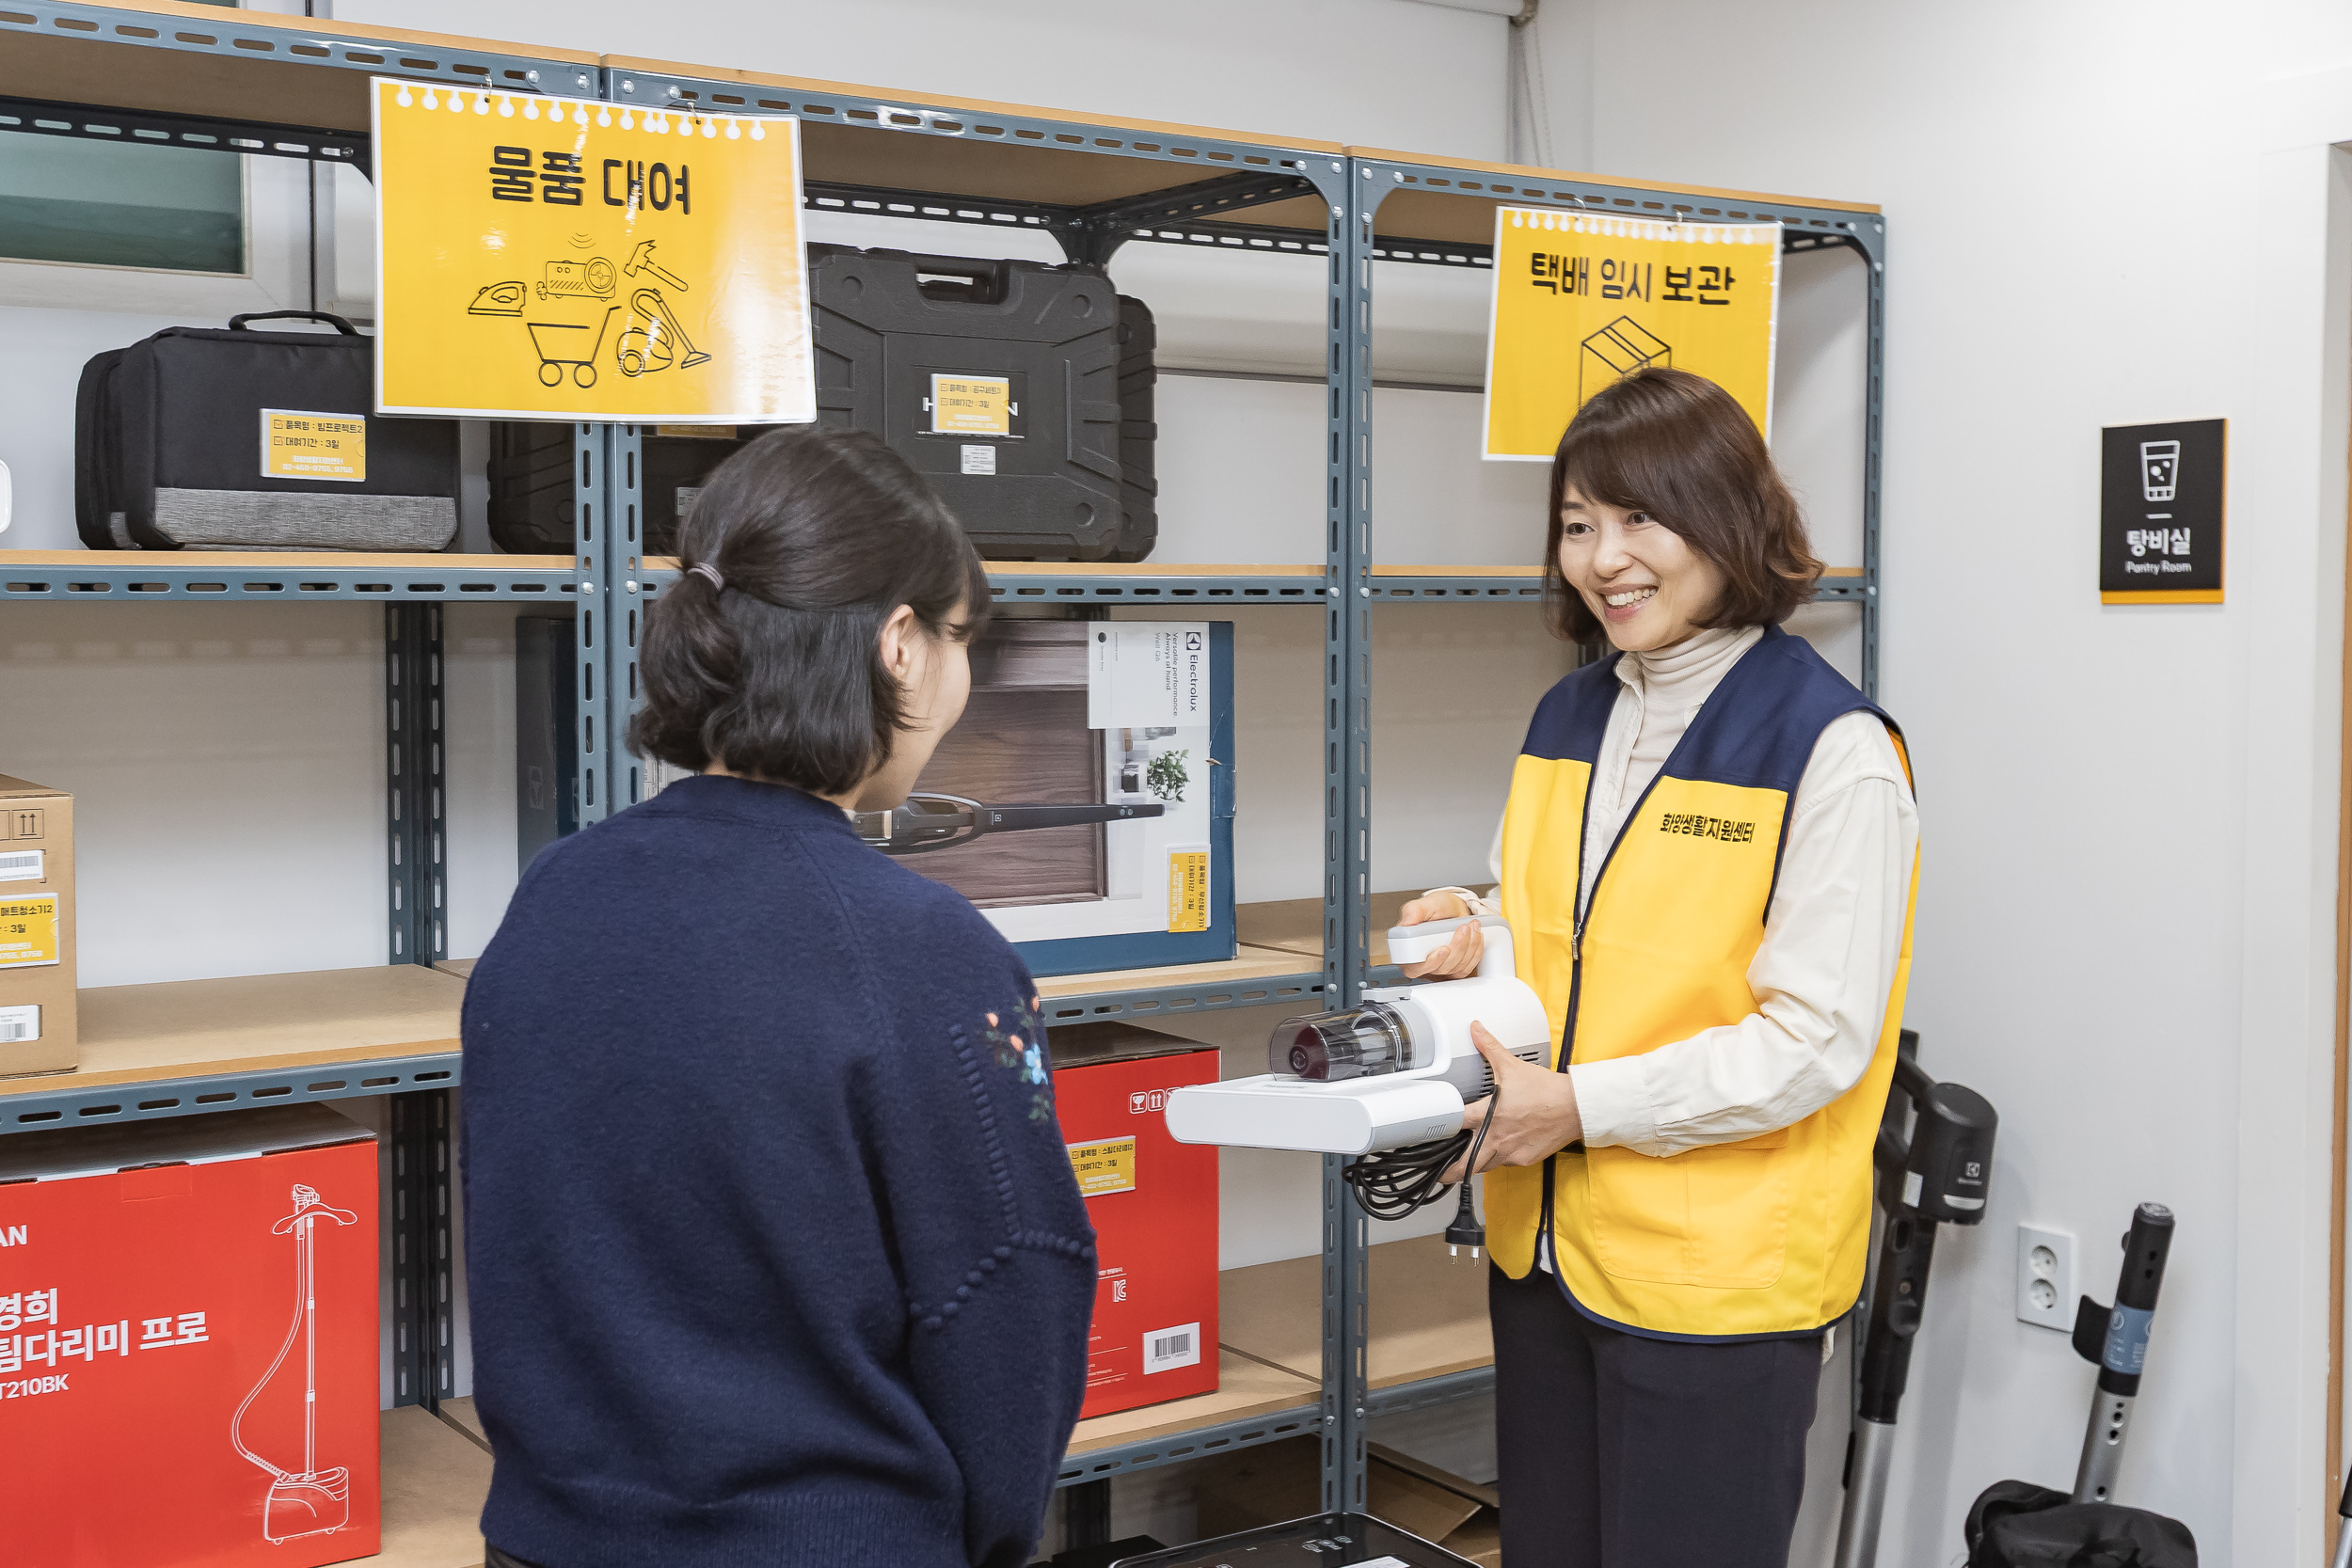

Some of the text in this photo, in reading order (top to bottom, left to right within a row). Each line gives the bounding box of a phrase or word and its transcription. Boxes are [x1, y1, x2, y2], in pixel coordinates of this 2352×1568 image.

[488, 145, 691, 215] 물품 대여
[1531, 252, 1737, 306] 택배 임시 보관
[285, 420, 310, 431] 품목명
[317, 422, 363, 434] 빔프로젝트2
[285, 436, 318, 448] 대여기간
[325, 439, 340, 450] 3일
[2126, 527, 2191, 558] 탕비실
[2124, 560, 2192, 576] Pantry Room
[1166, 660, 1172, 669] at
[1189, 655, 1199, 712] Electrolux
[0, 904, 53, 916] 매트청소기2
[9, 924, 26, 934] 3일
[139, 1310, 210, 1351] 프로
